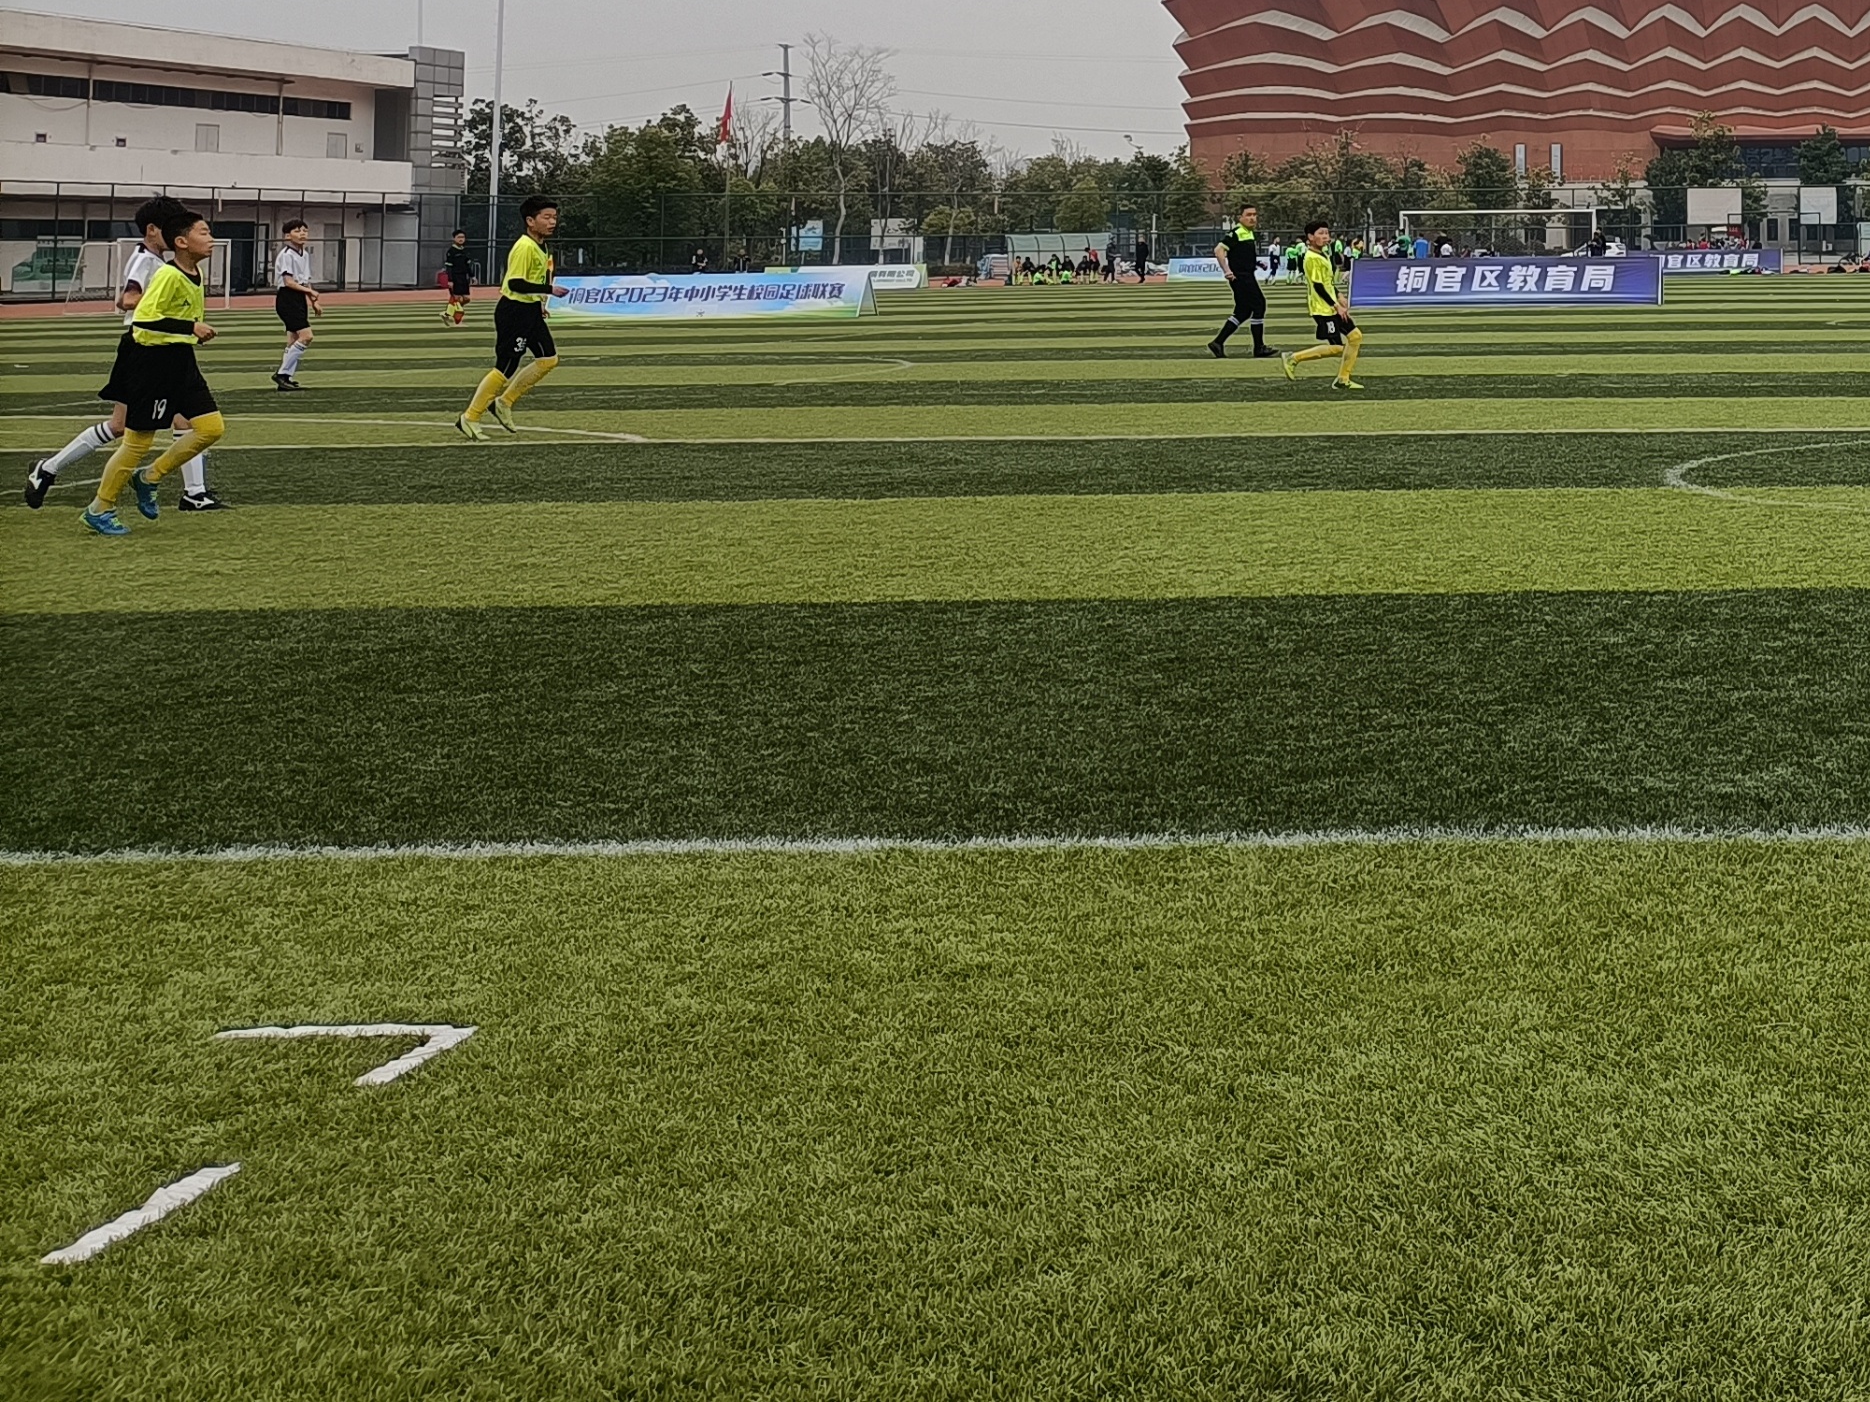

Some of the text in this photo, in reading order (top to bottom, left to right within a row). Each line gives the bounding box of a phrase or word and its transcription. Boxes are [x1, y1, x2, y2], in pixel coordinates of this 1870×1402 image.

[1660, 253, 1759, 268] 官区教育局
[1396, 265, 1616, 293] 铜官区教育局
[152, 399, 167, 420] 19
